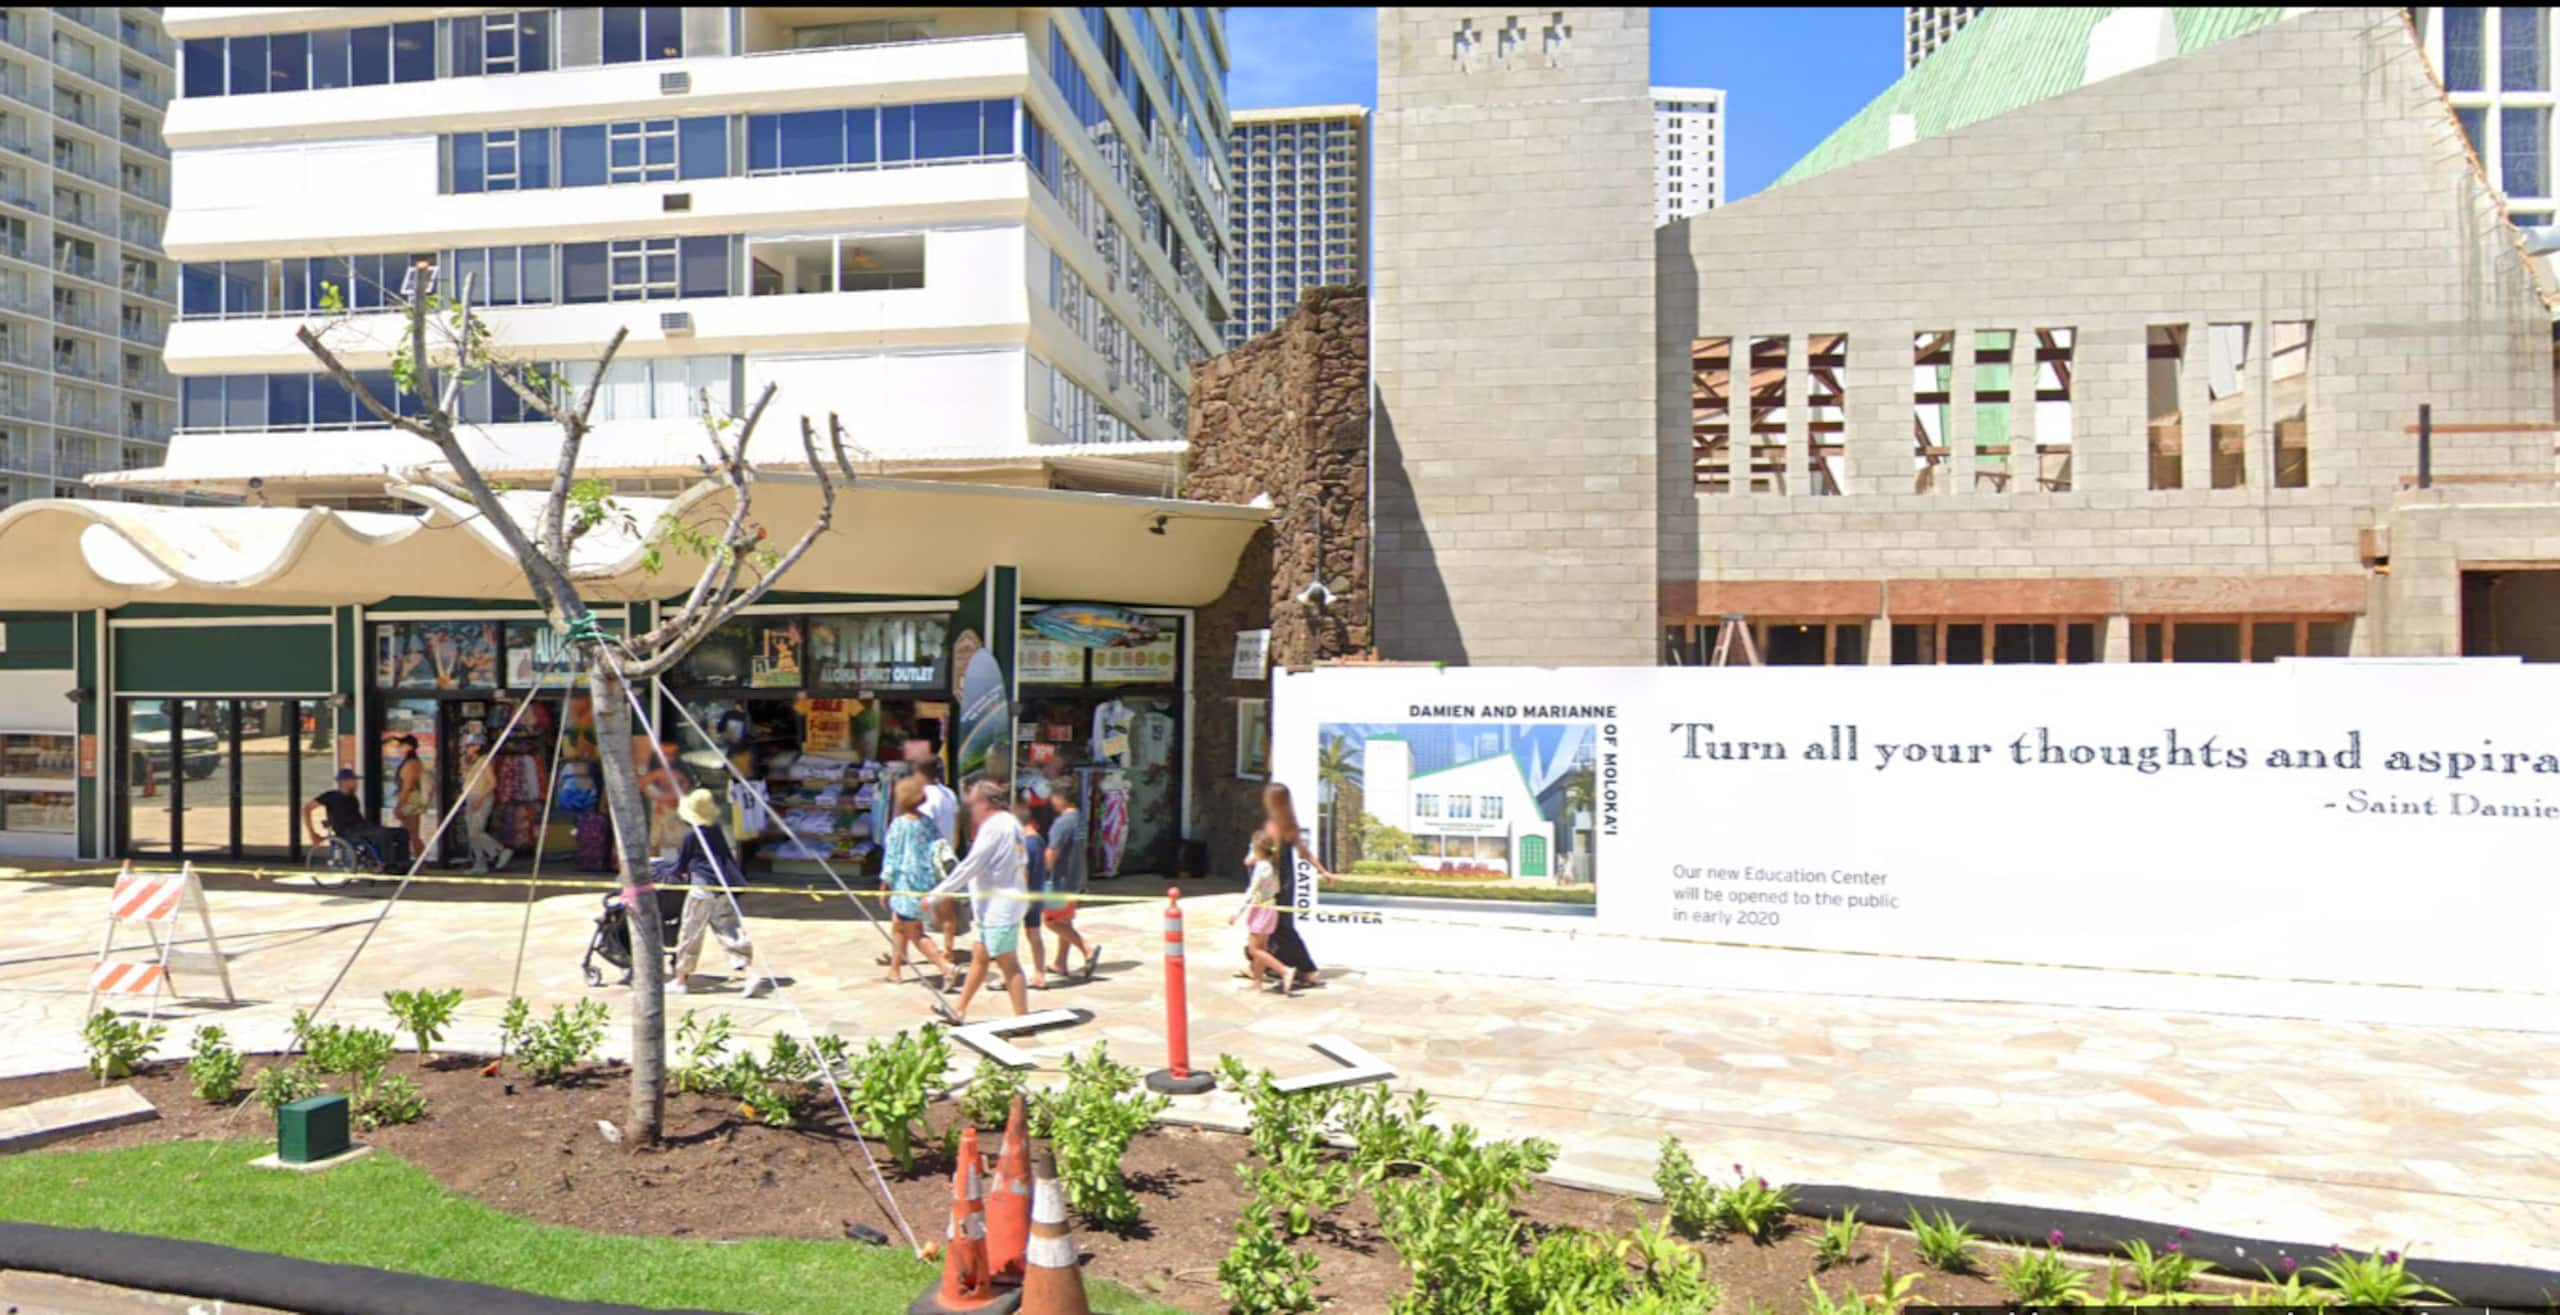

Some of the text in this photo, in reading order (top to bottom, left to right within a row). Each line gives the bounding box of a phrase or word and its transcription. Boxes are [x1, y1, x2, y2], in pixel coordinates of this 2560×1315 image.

[820, 667, 856, 682] ALOHA
[892, 666, 934, 681] OUTLET
[1410, 705, 1616, 718] DAMIEN AND MARIANNE
[1604, 724, 1617, 746] OF
[1670, 723, 2560, 779] Turn all your thoughts and aspira
[2346, 789, 2437, 816] Saint
[1672, 864, 1888, 886] Our new Education Center
[1673, 887, 1899, 909] will be opened to the public
[1673, 908, 1780, 926] in early 2020
